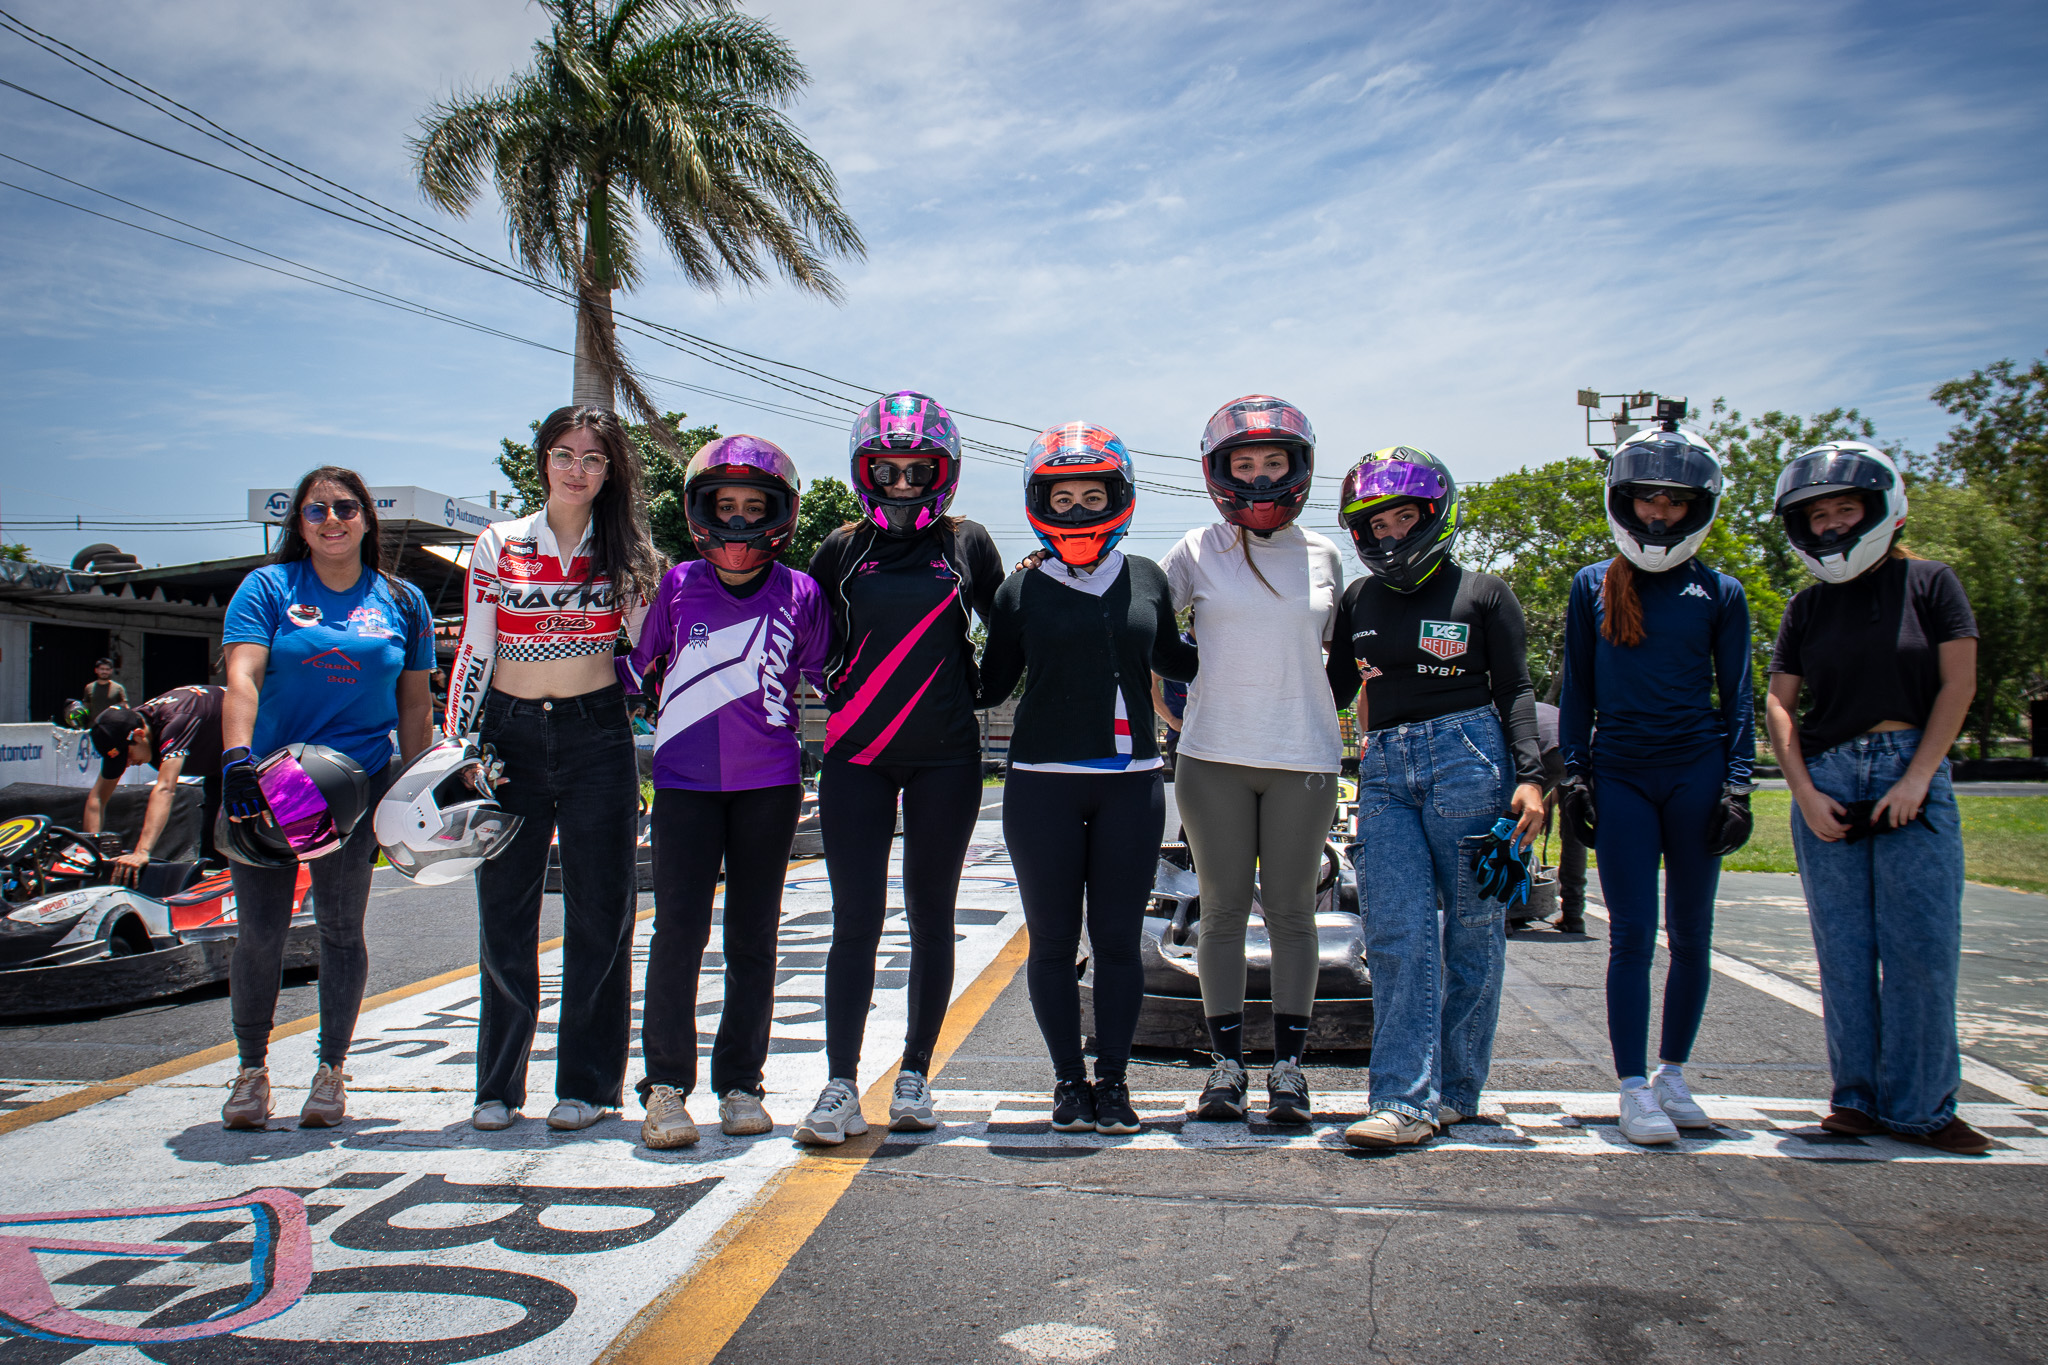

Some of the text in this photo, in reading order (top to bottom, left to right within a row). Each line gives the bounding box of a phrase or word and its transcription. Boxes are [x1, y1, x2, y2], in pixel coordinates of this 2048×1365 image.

[1052, 457, 1097, 467] LS2
[1429, 624, 1462, 640] TAG
[1423, 639, 1465, 657] HEUER
[312, 660, 352, 671] Casa
[456, 662, 467, 683] FOR
[1417, 664, 1466, 676] BYBIT
